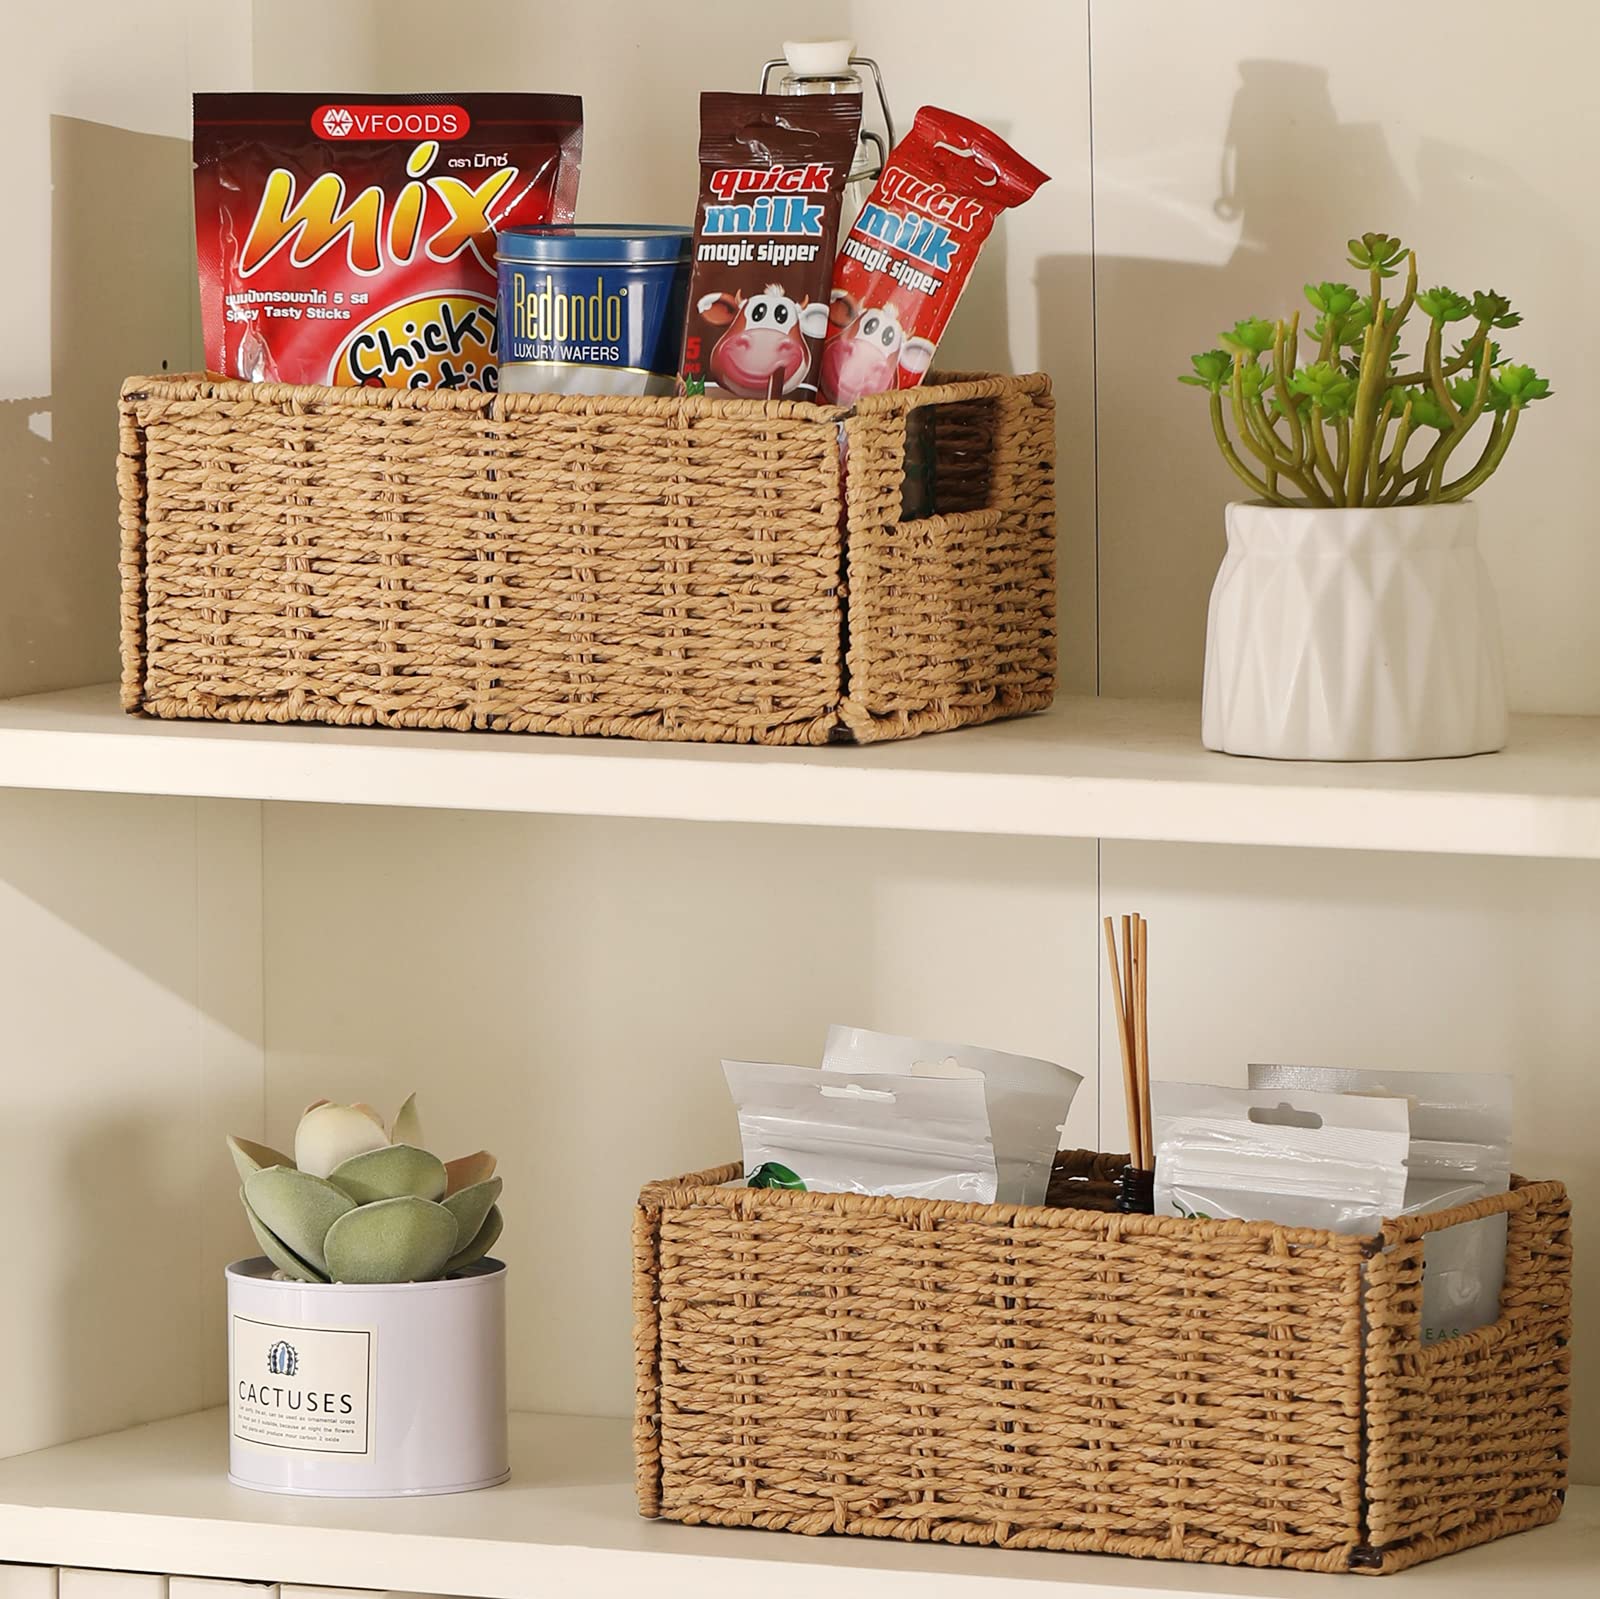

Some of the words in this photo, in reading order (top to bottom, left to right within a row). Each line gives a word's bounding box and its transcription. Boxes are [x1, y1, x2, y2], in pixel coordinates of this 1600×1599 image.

[354, 114, 458, 133] VFOODS
[448, 158, 471, 168] ตรา
[710, 163, 834, 200] quick
[238, 140, 519, 278] mix
[881, 166, 984, 233] quick
[701, 196, 825, 237] milk
[854, 201, 961, 274] milk
[697, 240, 755, 266] magic
[757, 240, 819, 266] sipper
[842, 237, 892, 273] magic
[889, 260, 942, 296] sipper
[333, 293, 343, 304] 5
[226, 309, 259, 323] Spicy
[264, 306, 302, 320] Tasty
[306, 307, 351, 320] Sticks
[514, 343, 556, 361] LUXURY
[560, 346, 620, 362] WAFERS
[686, 336, 702, 359] 5
[239, 1380, 353, 1414] CACTUSES
